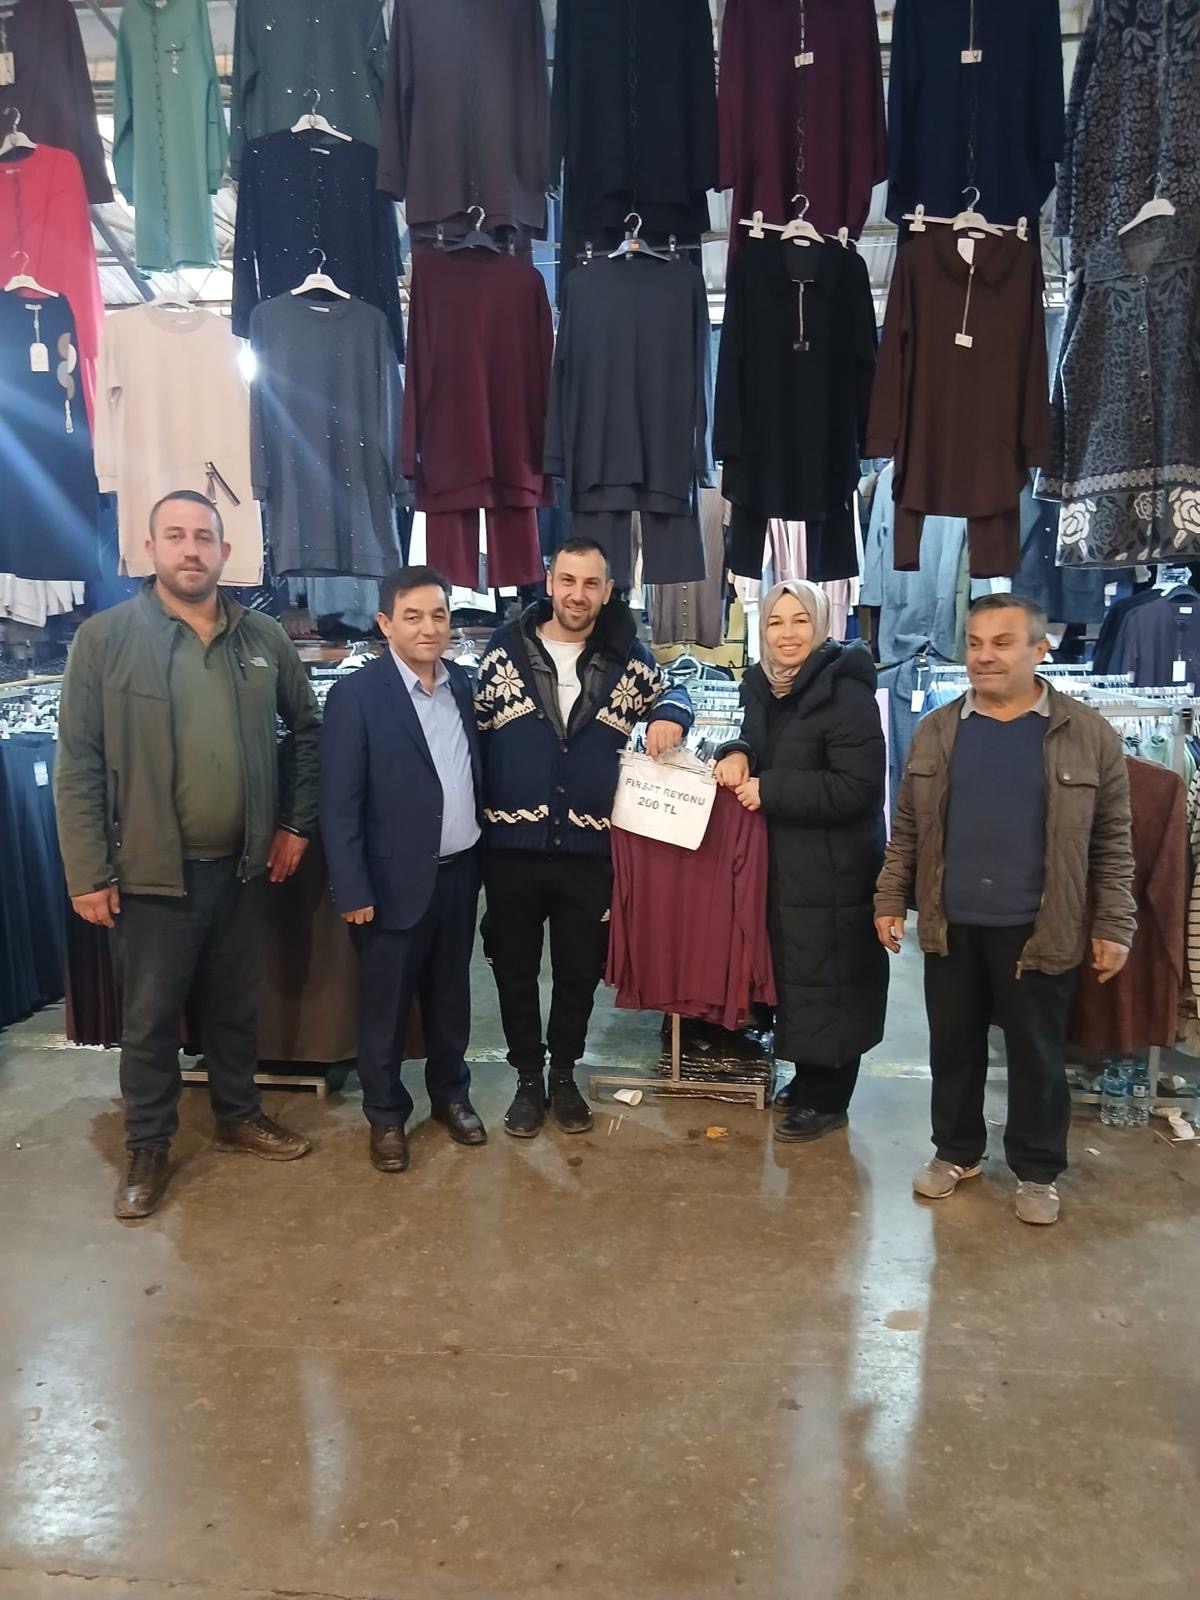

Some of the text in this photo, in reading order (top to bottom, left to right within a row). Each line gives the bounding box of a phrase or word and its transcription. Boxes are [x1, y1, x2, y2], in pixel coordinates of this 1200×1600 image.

[625, 778, 706, 806] FIRSAT REYONU
[638, 796, 677, 815] 200 TL
